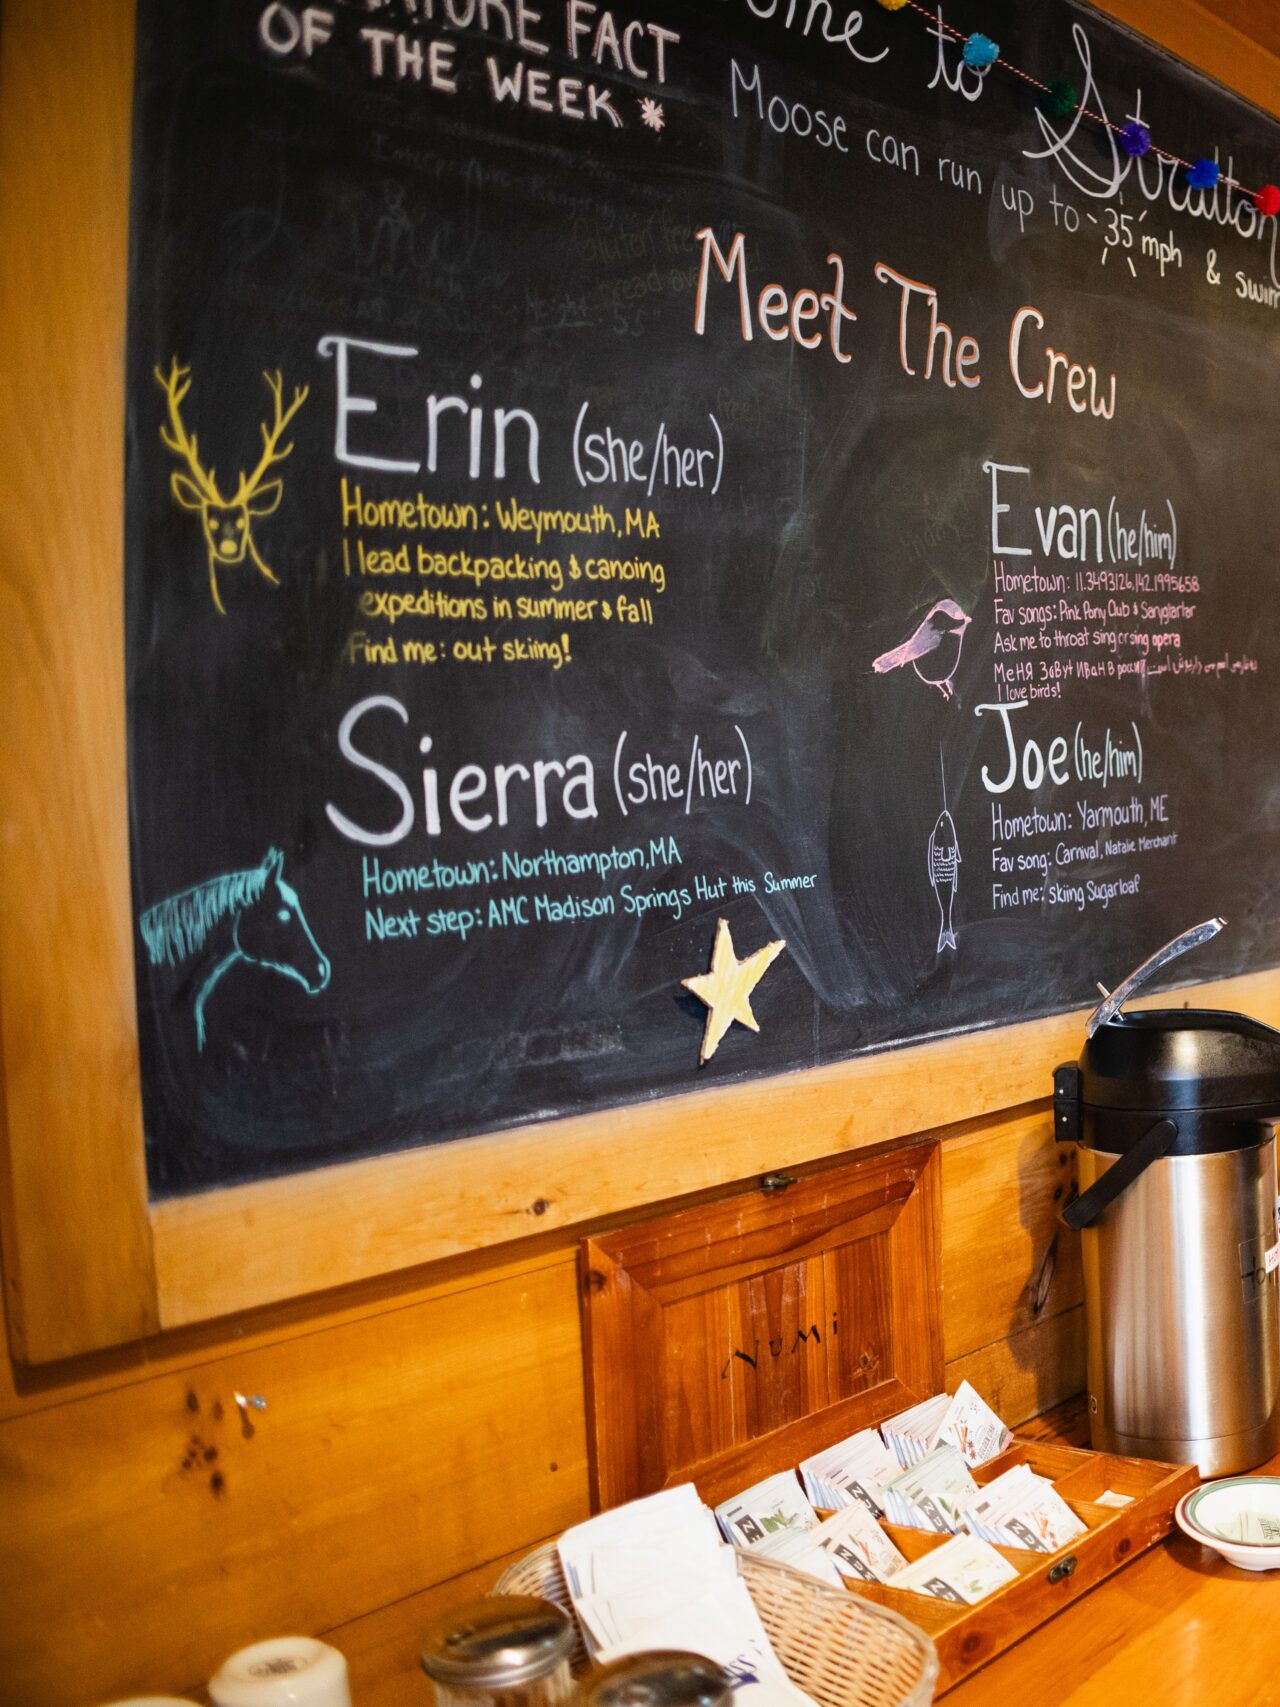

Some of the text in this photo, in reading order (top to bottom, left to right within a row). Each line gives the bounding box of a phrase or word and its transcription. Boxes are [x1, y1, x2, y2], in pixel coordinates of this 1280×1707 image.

[259, 2, 624, 128] OF THE WEEK
[567, 0, 681, 84] FACT
[926, 5, 993, 101] to
[730, 58, 849, 153] Moose
[865, 128, 919, 176] can
[938, 156, 983, 194] run
[1000, 184, 1034, 232] up
[1049, 185, 1080, 232] to
[1104, 208, 1134, 248] 35
[1142, 231, 1182, 276] mph
[1206, 249, 1221, 285] &
[694, 227, 857, 363] Meet
[874, 262, 981, 388] The
[1009, 306, 1117, 420] Crew
[317, 335, 724, 497] Erin (she/her)
[341, 477, 660, 544] Hometown: Weymouth, MA
[982, 461, 1177, 570] Evan (he/him)
[357, 539, 410, 575] lead
[417, 543, 563, 591] backpacking
[585, 555, 666, 593] canoing
[993, 560, 1070, 593] Hometown:
[361, 588, 487, 623] expeditions
[492, 590, 512, 620] in
[517, 594, 599, 623] summer
[616, 596, 653, 625] fall
[994, 599, 1014, 625] Fav
[1019, 604, 1056, 632] songs:
[1059, 599, 1082, 621] Pink
[1082, 602, 1107, 626] Pony
[348, 631, 572, 670] Find me: out skiing!
[993, 631, 1018, 654] Ask
[1020, 636, 1038, 651] me
[1039, 631, 1052, 648] to
[1053, 627, 1090, 647] throat
[1092, 628, 1117, 655] sing
[1130, 630, 1150, 656] sing
[1152, 631, 1182, 652] opera
[1005, 684, 1028, 700] love
[1029, 682, 1062, 700] birds!
[326, 695, 753, 846] Sierra (she/her)
[974, 699, 1143, 793] Joe (he/him)
[991, 794, 1169, 841] Hometown: Yarmouth, ME
[362, 855, 499, 899] Hometown:
[992, 847, 1014, 872] Fav
[1018, 852, 1052, 877] song:
[1055, 841, 1103, 866] Carnival,
[364, 872, 818, 941] Next step: AMC Madison Springs Hut this Summer
[992, 873, 1141, 911] Find me: skiing Sugarloaf
